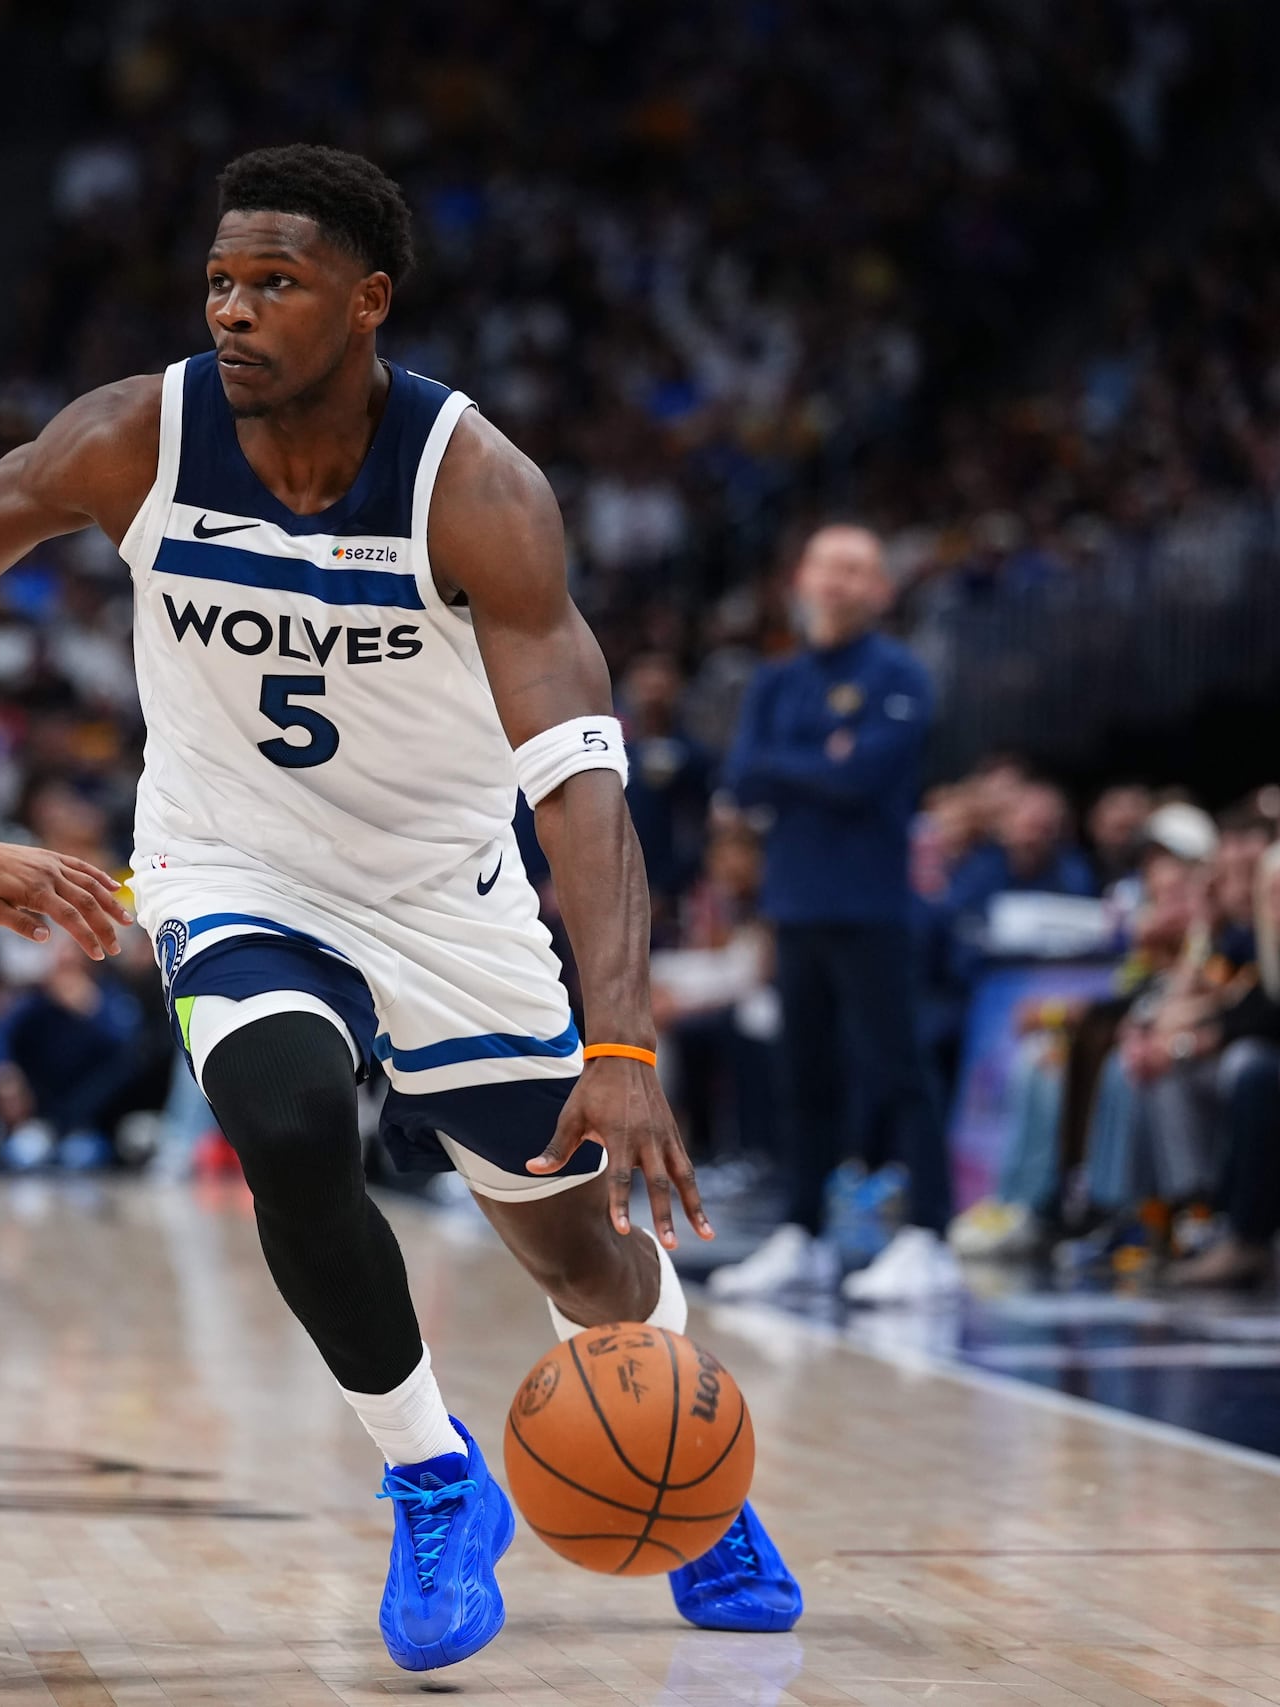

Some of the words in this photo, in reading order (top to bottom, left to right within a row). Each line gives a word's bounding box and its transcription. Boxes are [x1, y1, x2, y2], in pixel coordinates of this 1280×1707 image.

[344, 545, 398, 564] sezzle
[161, 592, 424, 668] WOLVES
[256, 673, 340, 769] 5
[582, 730, 609, 752] 5
